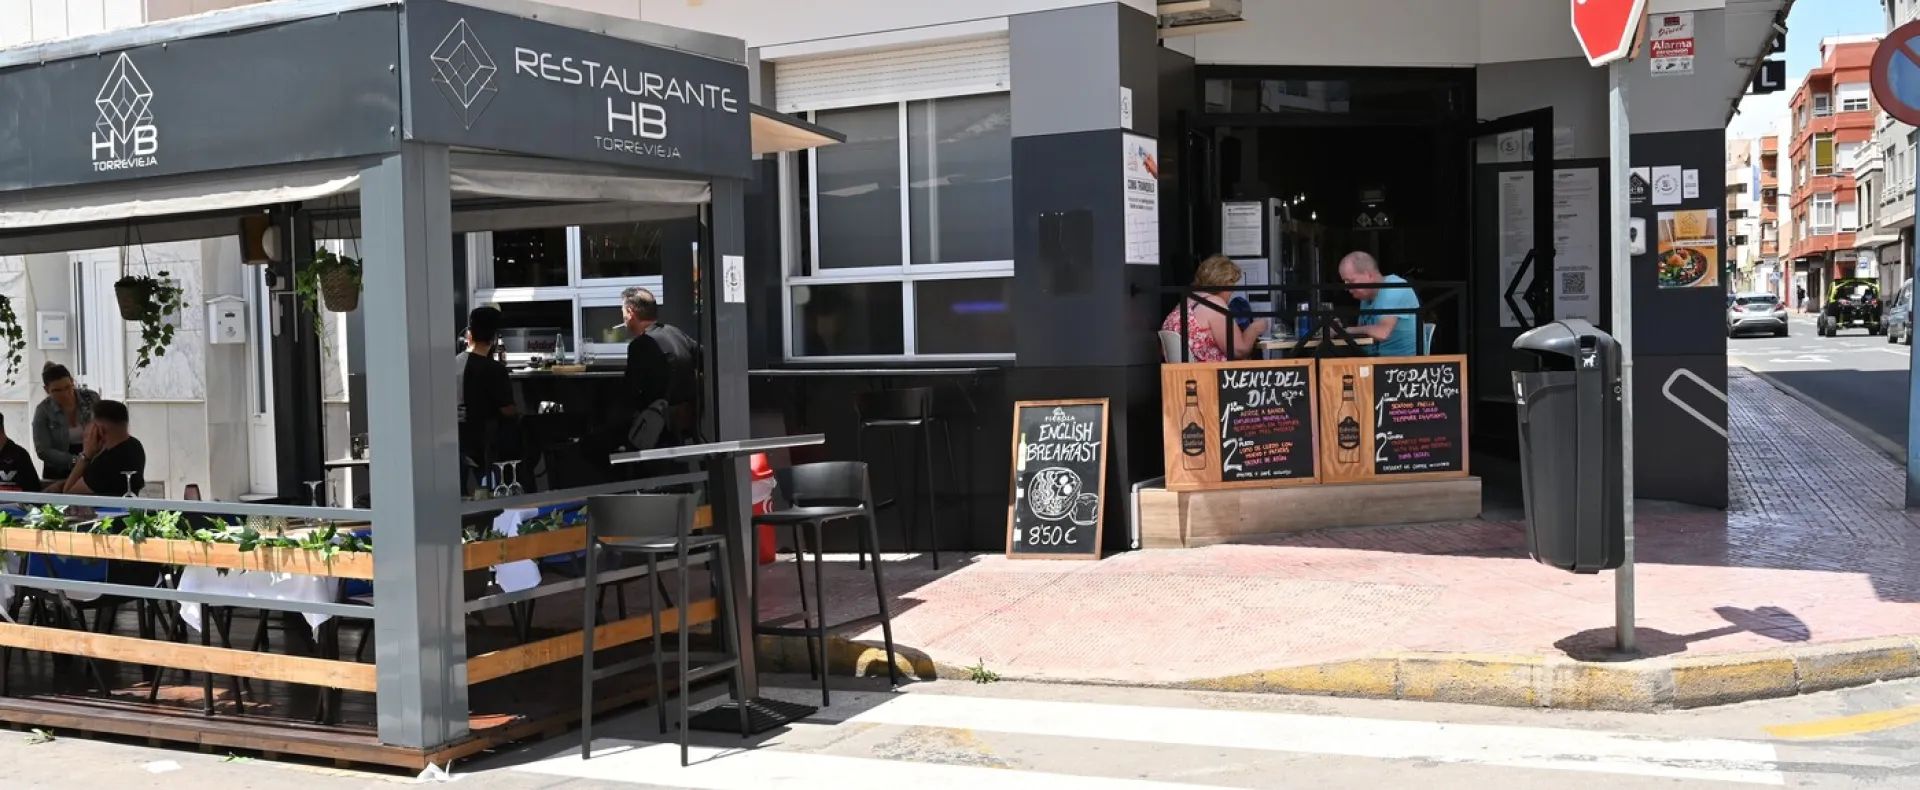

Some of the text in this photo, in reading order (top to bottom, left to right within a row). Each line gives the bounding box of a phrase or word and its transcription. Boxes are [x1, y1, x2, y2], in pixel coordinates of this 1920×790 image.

[1652, 39, 1692, 50] Alarma
[515, 46, 738, 113] RESTAURANTE
[607, 97, 667, 140] HB
[594, 135, 681, 159] TORREVIEJA
[93, 155, 158, 172] TORREVIEJA
[1274, 371, 1306, 387] DEL
[1385, 364, 1454, 384] TODAY'S
[1397, 381, 1444, 398] MENU
[1038, 421, 1093, 442] ENGLISH
[1025, 441, 1102, 462] BREAKFAST
